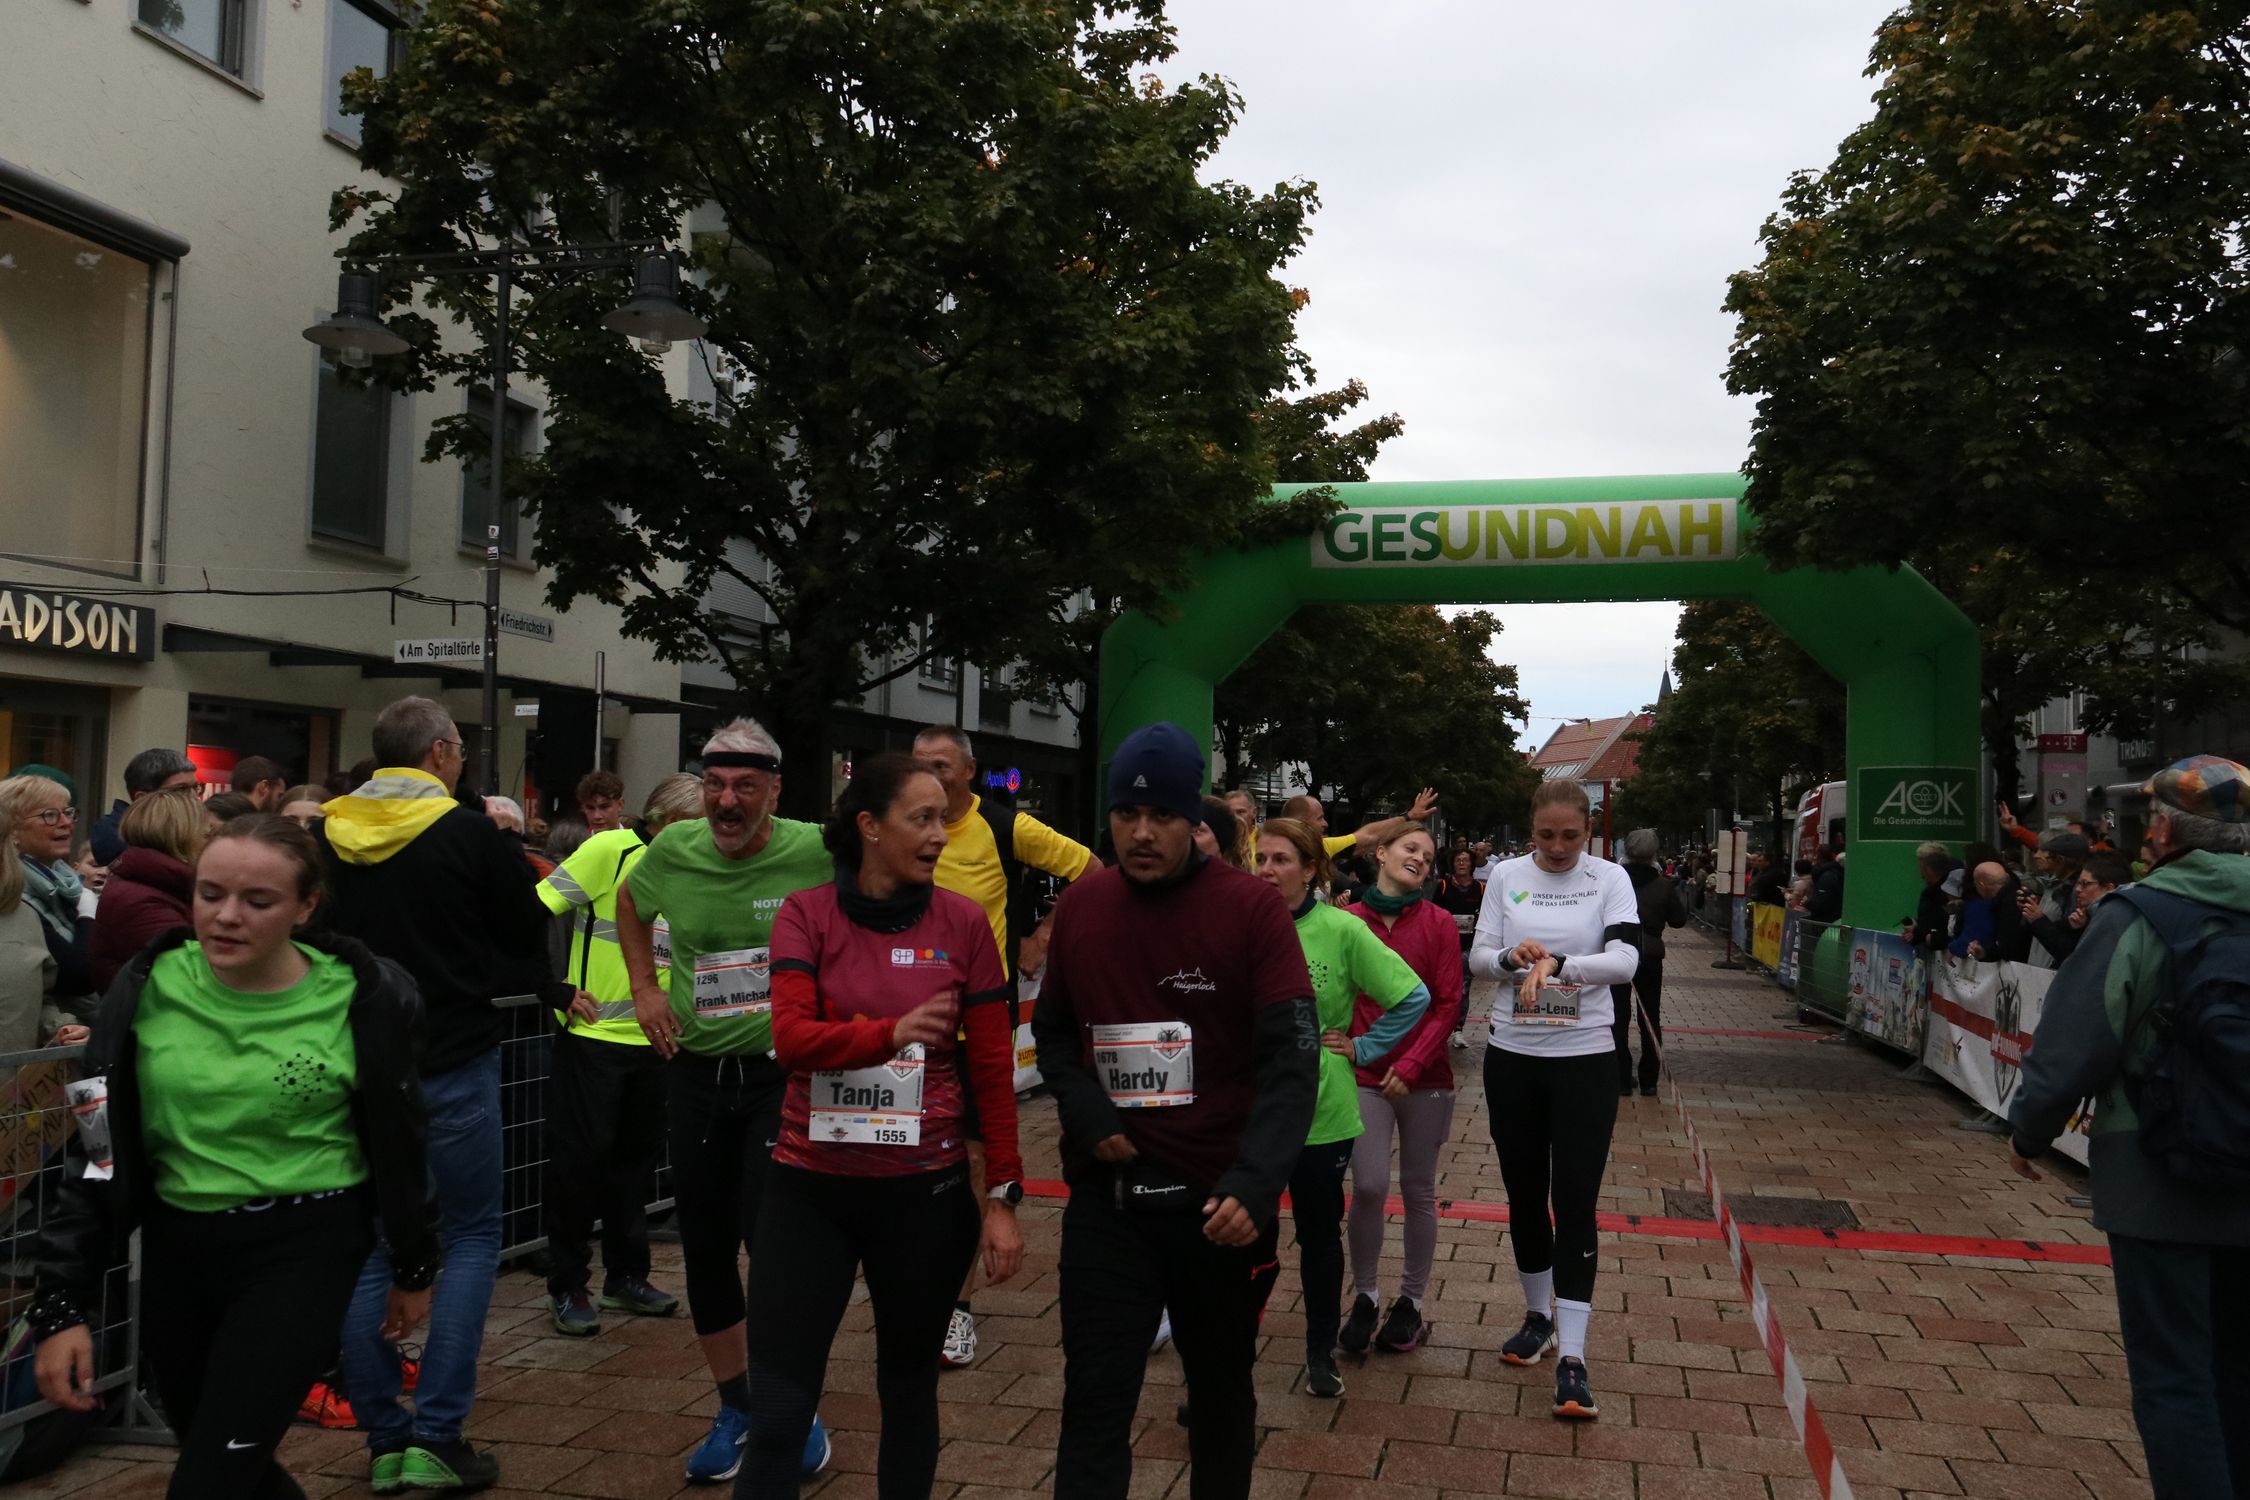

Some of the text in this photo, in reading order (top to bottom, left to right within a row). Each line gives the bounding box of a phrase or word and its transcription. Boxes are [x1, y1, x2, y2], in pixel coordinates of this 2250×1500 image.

[1323, 503, 1723, 562] GESUNDNAH
[407, 641, 481, 659] Am Spitaltörle
[1876, 780, 1964, 815] AOK
[1873, 817, 1886, 825] Die
[1532, 892, 1553, 900] UNSER
[696, 973, 719, 985] 1296
[1173, 981, 1216, 994] Haigerloch
[695, 994, 728, 1008] Frank
[1095, 1051, 1119, 1064] 1678
[1109, 1067, 1168, 1093] Hardy
[830, 1082, 894, 1111] Tanja
[874, 1129, 907, 1143] 1555
[1132, 1184, 1187, 1195] Champion
